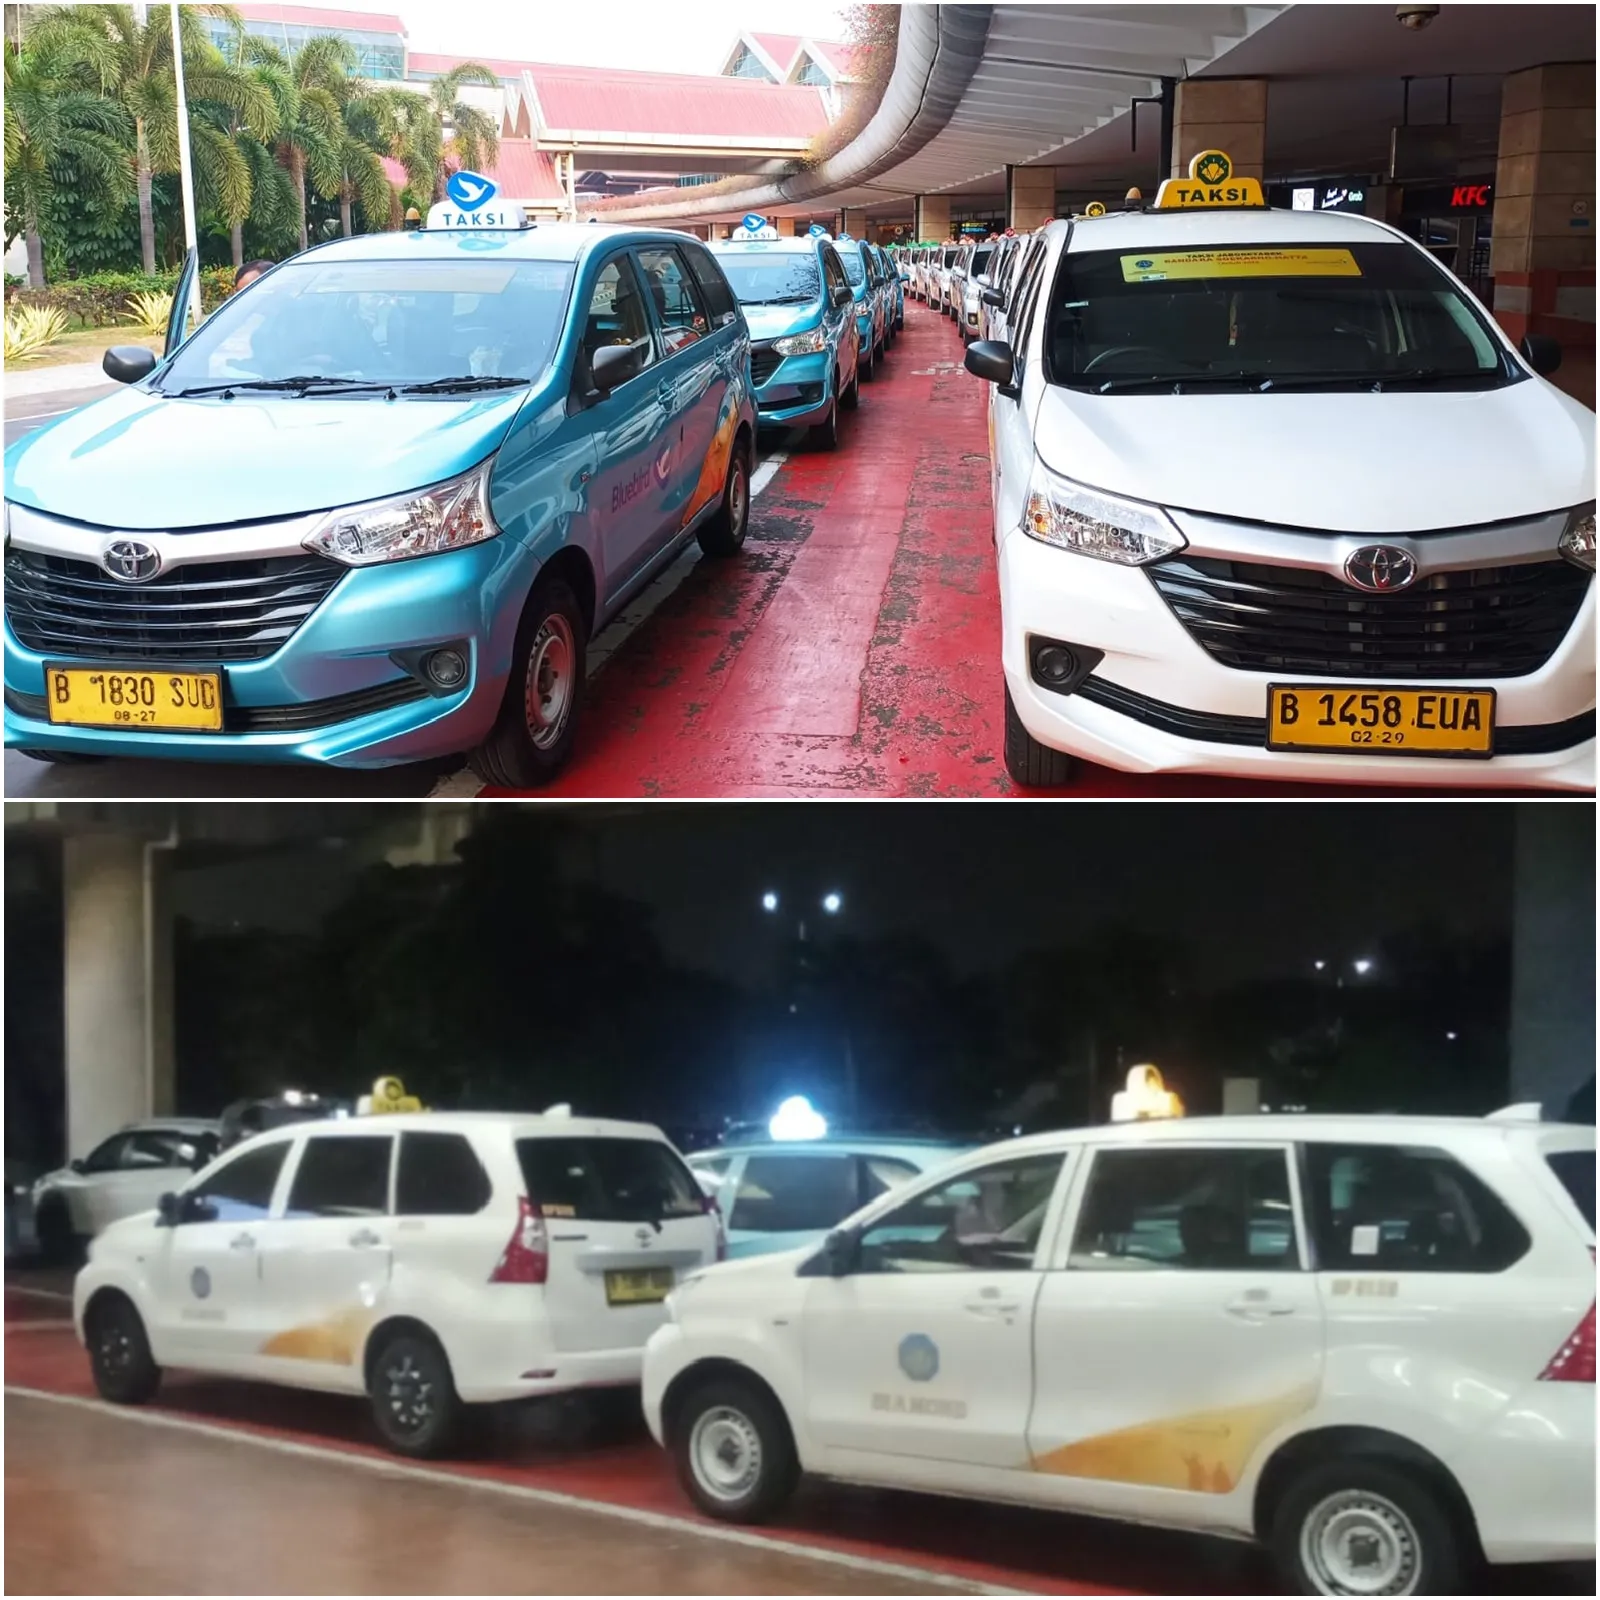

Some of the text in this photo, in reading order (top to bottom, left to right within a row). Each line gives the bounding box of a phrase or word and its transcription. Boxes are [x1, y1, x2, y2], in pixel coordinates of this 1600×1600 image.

[1177, 187, 1248, 202] TAKSI
[1451, 186, 1488, 206] KFC
[442, 212, 504, 226] TAKSI
[612, 461, 651, 514] Bluebird
[54, 673, 70, 704] B
[96, 674, 155, 706] 1830
[1280, 693, 1481, 731] B 1458 EUA
